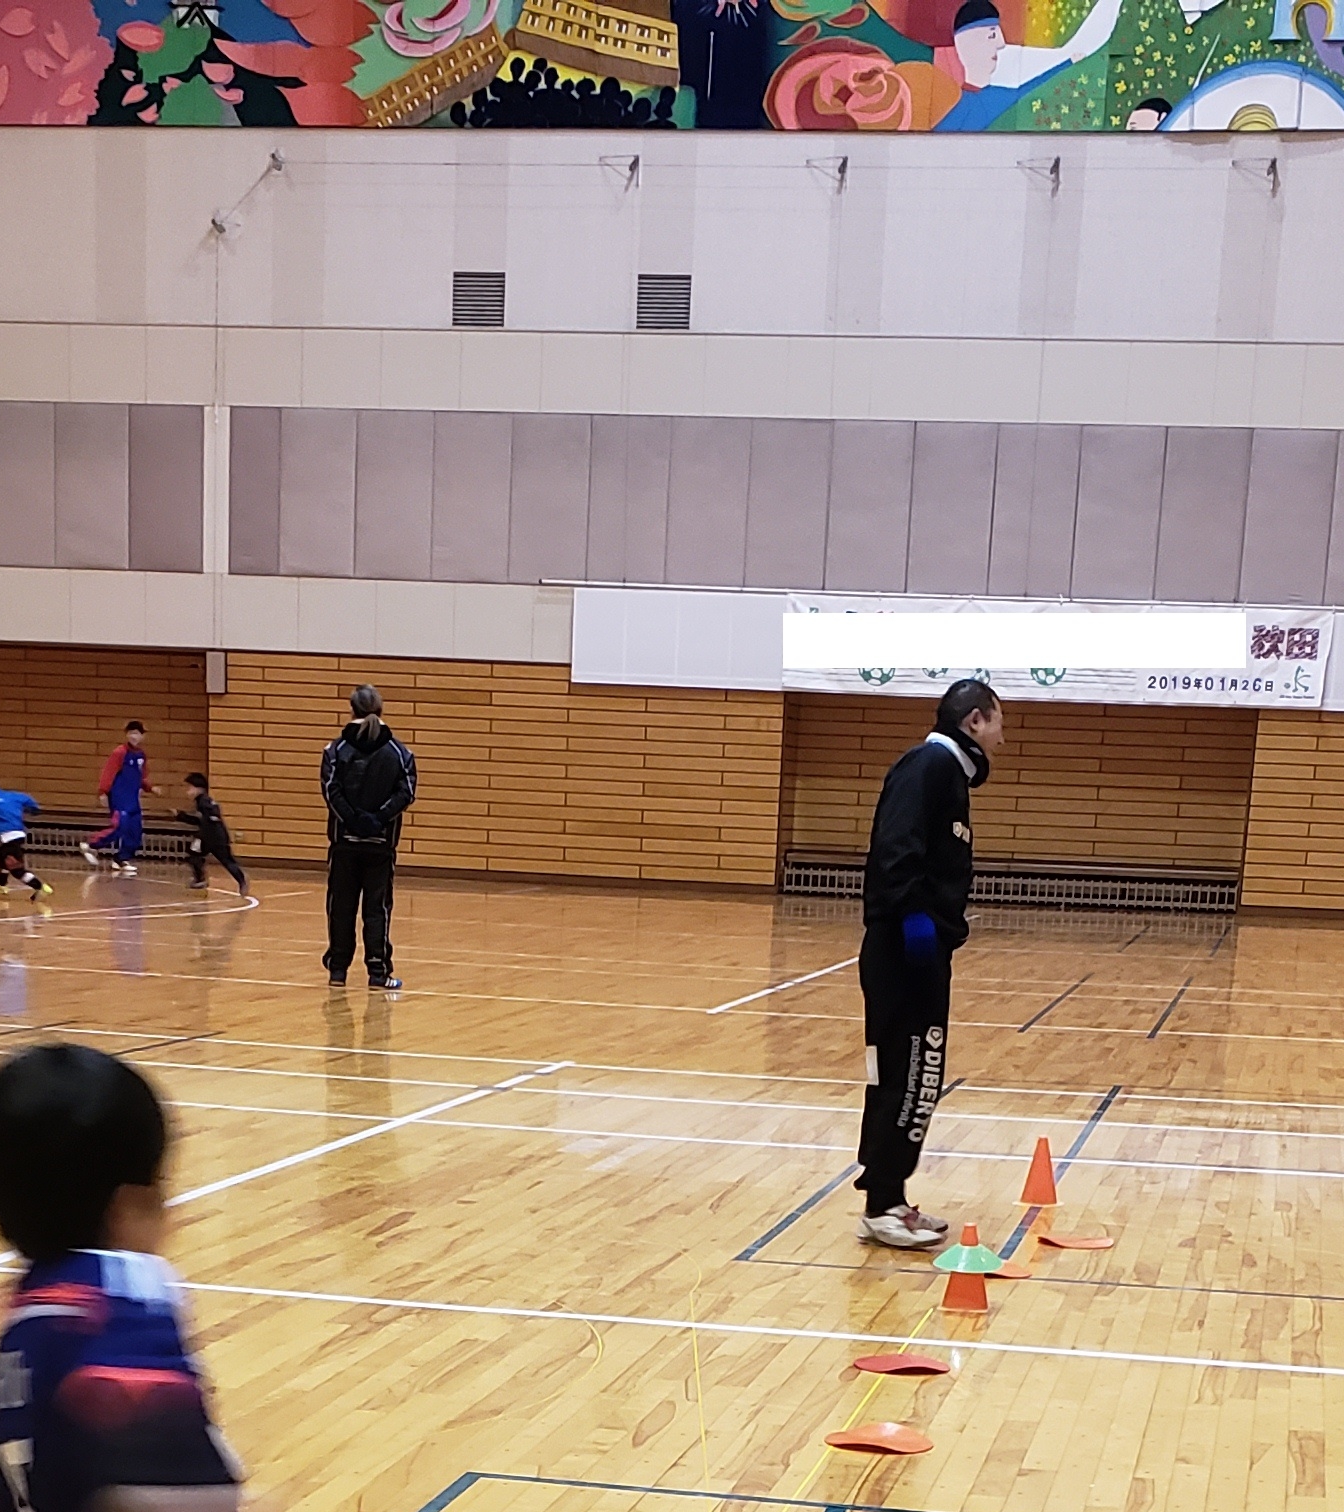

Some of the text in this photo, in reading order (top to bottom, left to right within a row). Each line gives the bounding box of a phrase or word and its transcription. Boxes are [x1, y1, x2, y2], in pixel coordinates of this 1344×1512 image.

[1250, 624, 1320, 661] 秋田
[1147, 675, 1274, 693] 2019年01月26日
